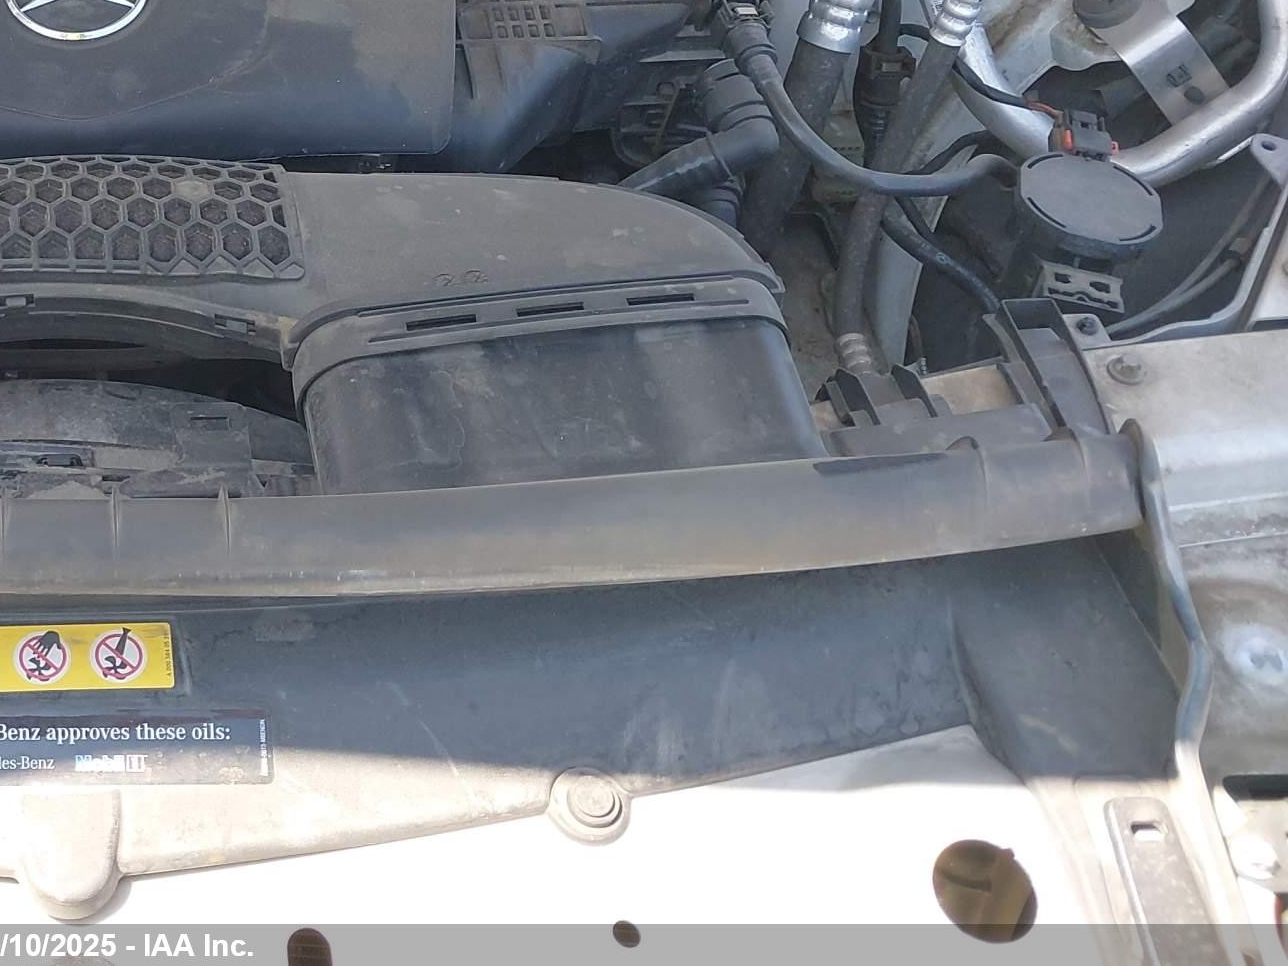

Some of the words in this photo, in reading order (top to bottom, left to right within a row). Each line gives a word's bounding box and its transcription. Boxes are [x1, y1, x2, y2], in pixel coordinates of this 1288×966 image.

[46, 726, 130, 745] approves
[135, 722, 186, 740] these
[191, 722, 231, 740] oils:
